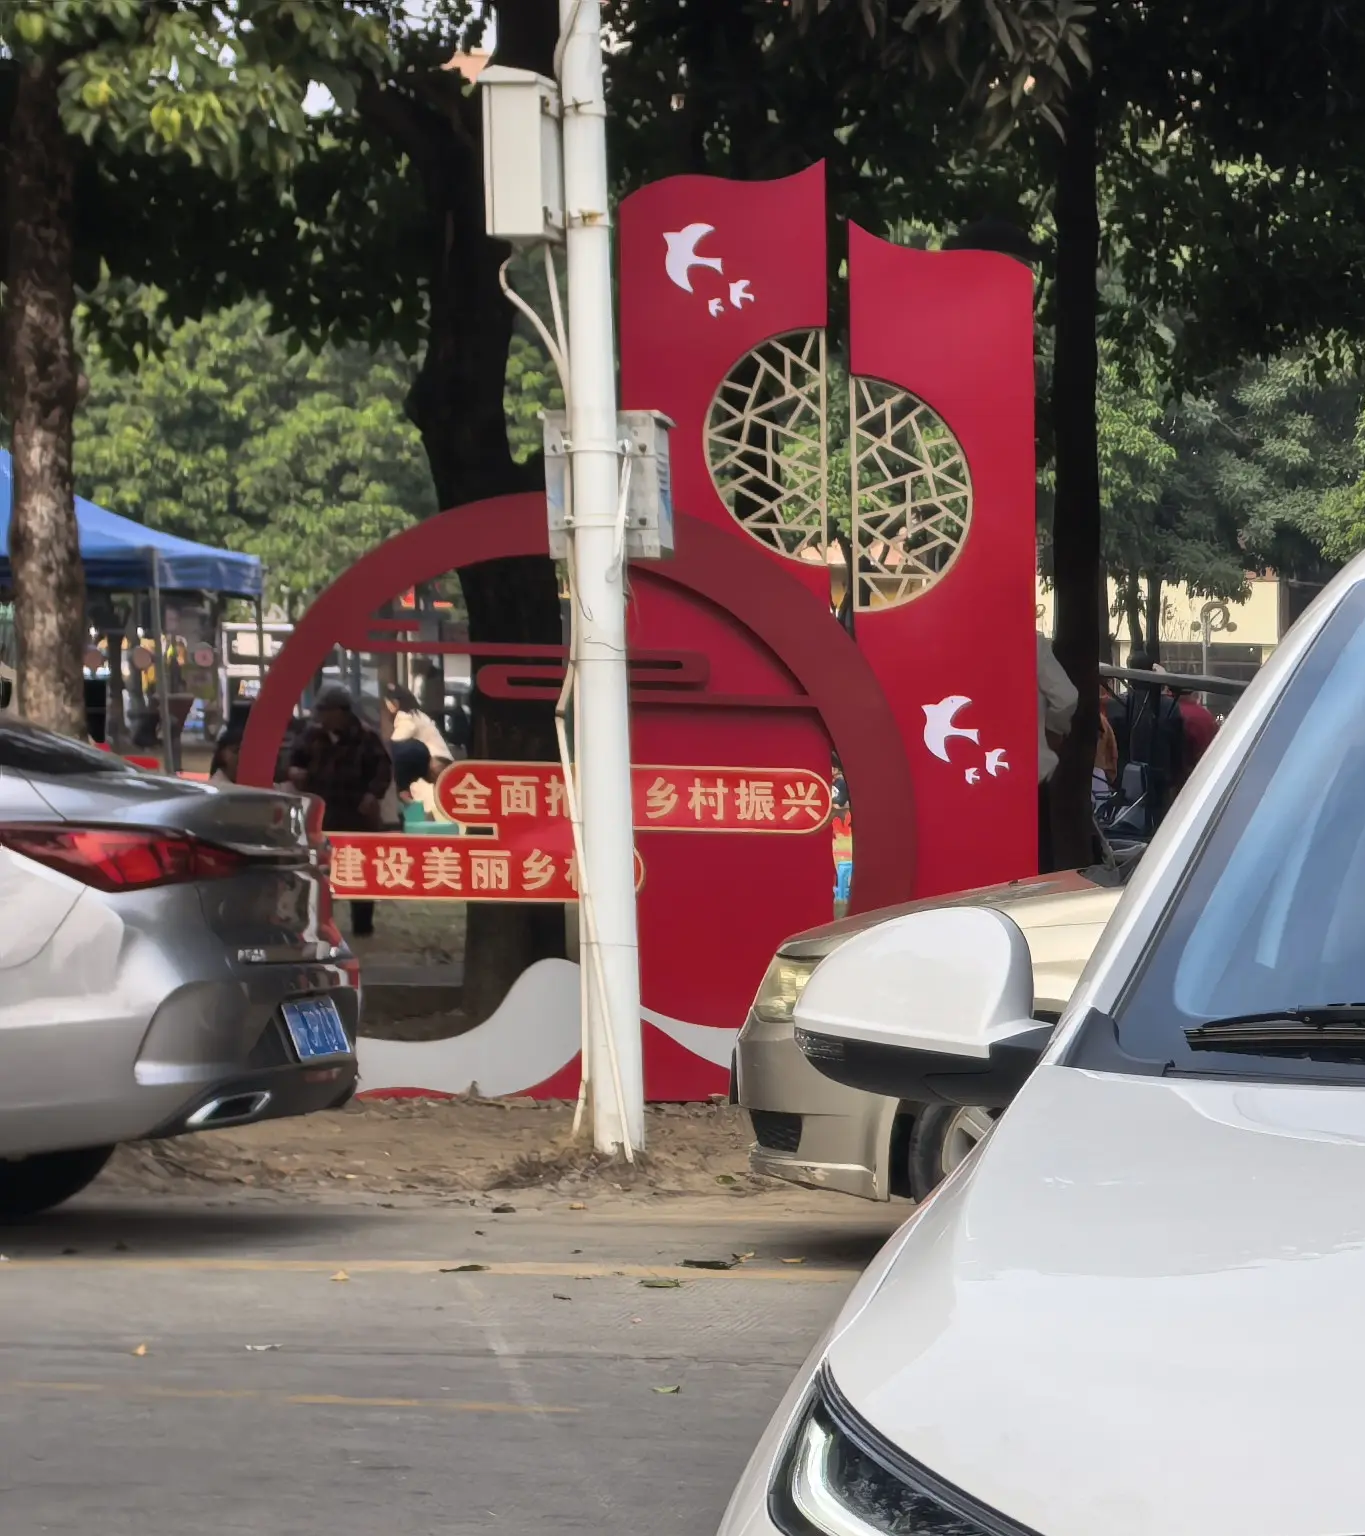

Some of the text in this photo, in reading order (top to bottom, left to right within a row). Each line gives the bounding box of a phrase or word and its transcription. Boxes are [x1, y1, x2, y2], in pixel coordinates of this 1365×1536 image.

[450, 772, 822, 822] 全面乡村振兴
